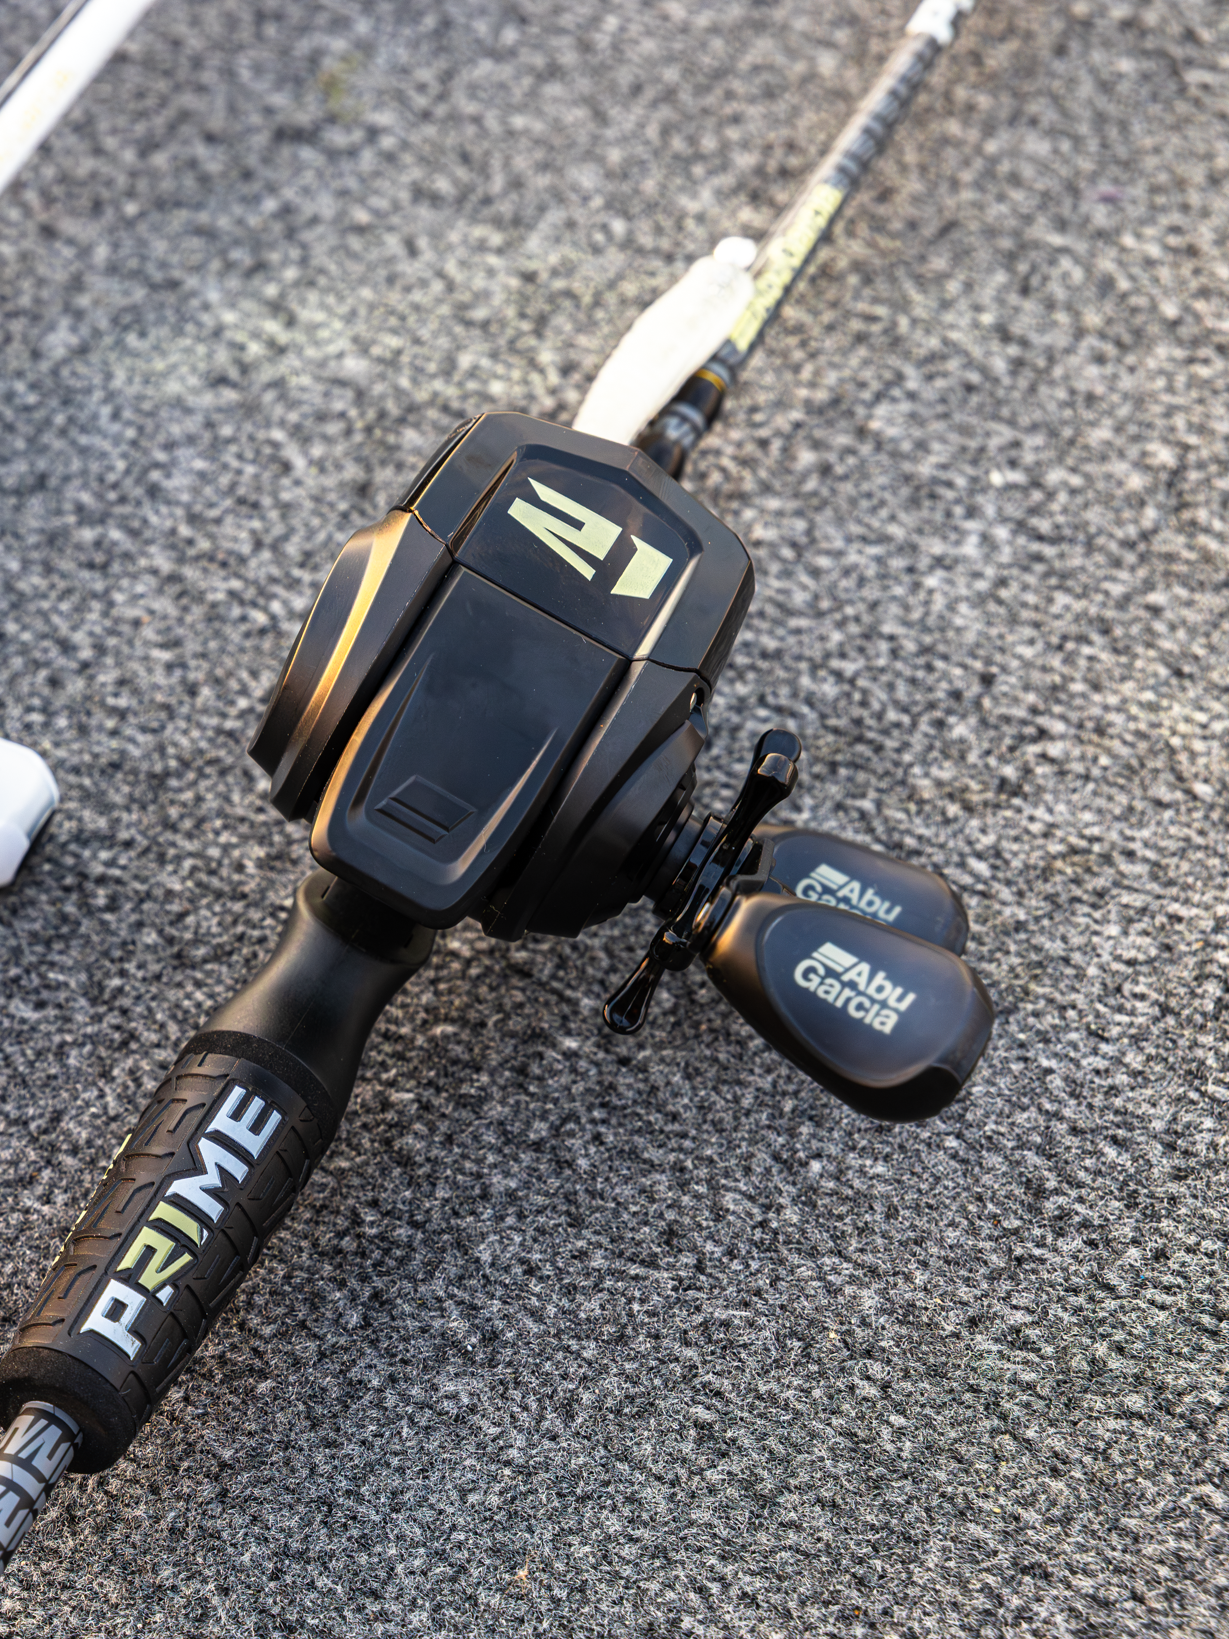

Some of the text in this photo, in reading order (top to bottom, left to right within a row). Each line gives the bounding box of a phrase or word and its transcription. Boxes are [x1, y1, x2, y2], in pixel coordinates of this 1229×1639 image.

[835, 879, 903, 922] Abu
[793, 958, 900, 1035] Garcia
[840, 961, 918, 1013] Abu
